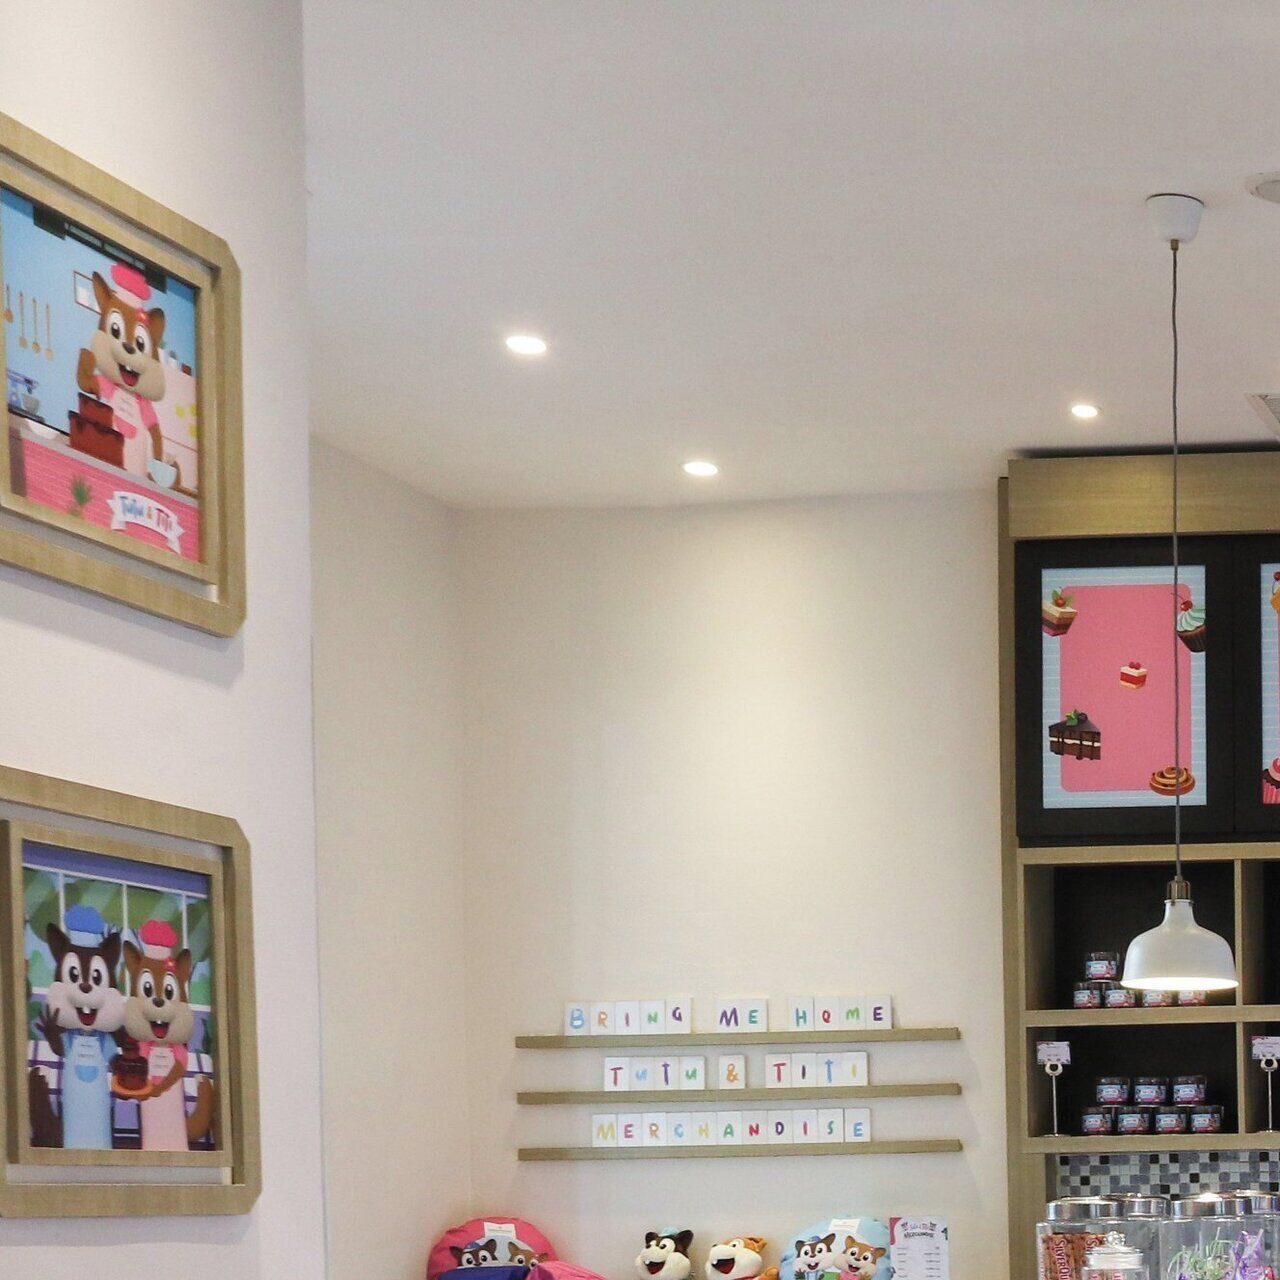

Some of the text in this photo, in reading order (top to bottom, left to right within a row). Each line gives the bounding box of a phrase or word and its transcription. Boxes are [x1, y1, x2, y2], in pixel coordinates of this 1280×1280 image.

[570, 1006, 883, 1030] BRING ME HOME
[726, 1063, 738, 1083] &
[596, 1120, 864, 1140] MERCHANDISE
